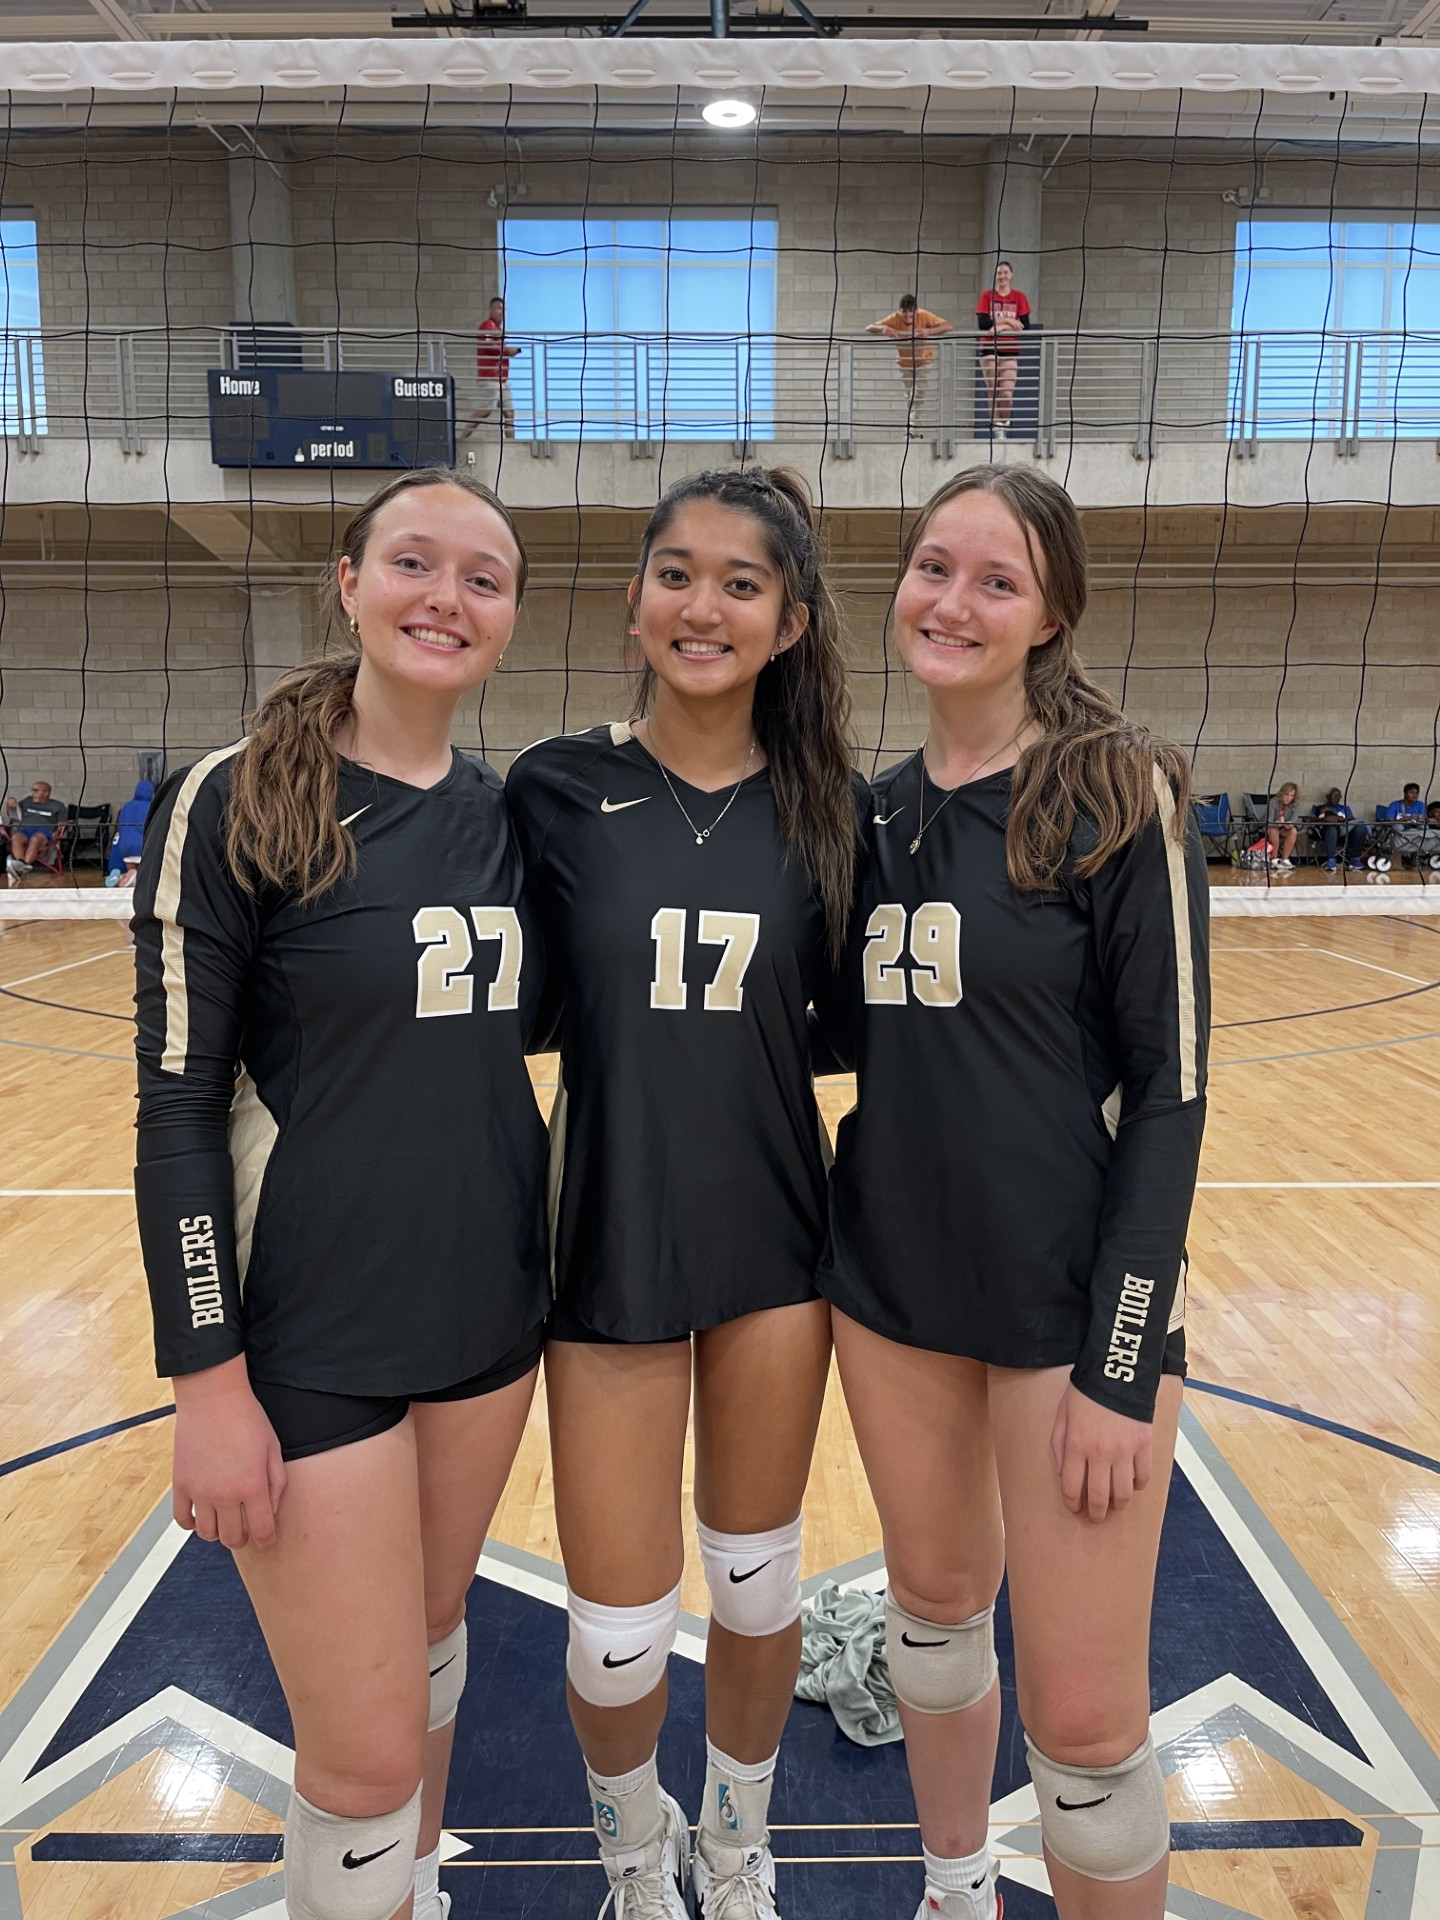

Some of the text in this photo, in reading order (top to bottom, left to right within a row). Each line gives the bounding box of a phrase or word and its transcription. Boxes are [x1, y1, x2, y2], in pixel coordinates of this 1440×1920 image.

[220, 376, 260, 395] Home
[394, 378, 444, 398] Guests
[310, 440, 354, 461] period
[412, 906, 523, 1018] 27
[650, 907, 760, 1012] 17
[863, 902, 963, 1007] 29
[179, 1215, 224, 1328] BOILERS
[1103, 1272, 1155, 1383] BOILERS
